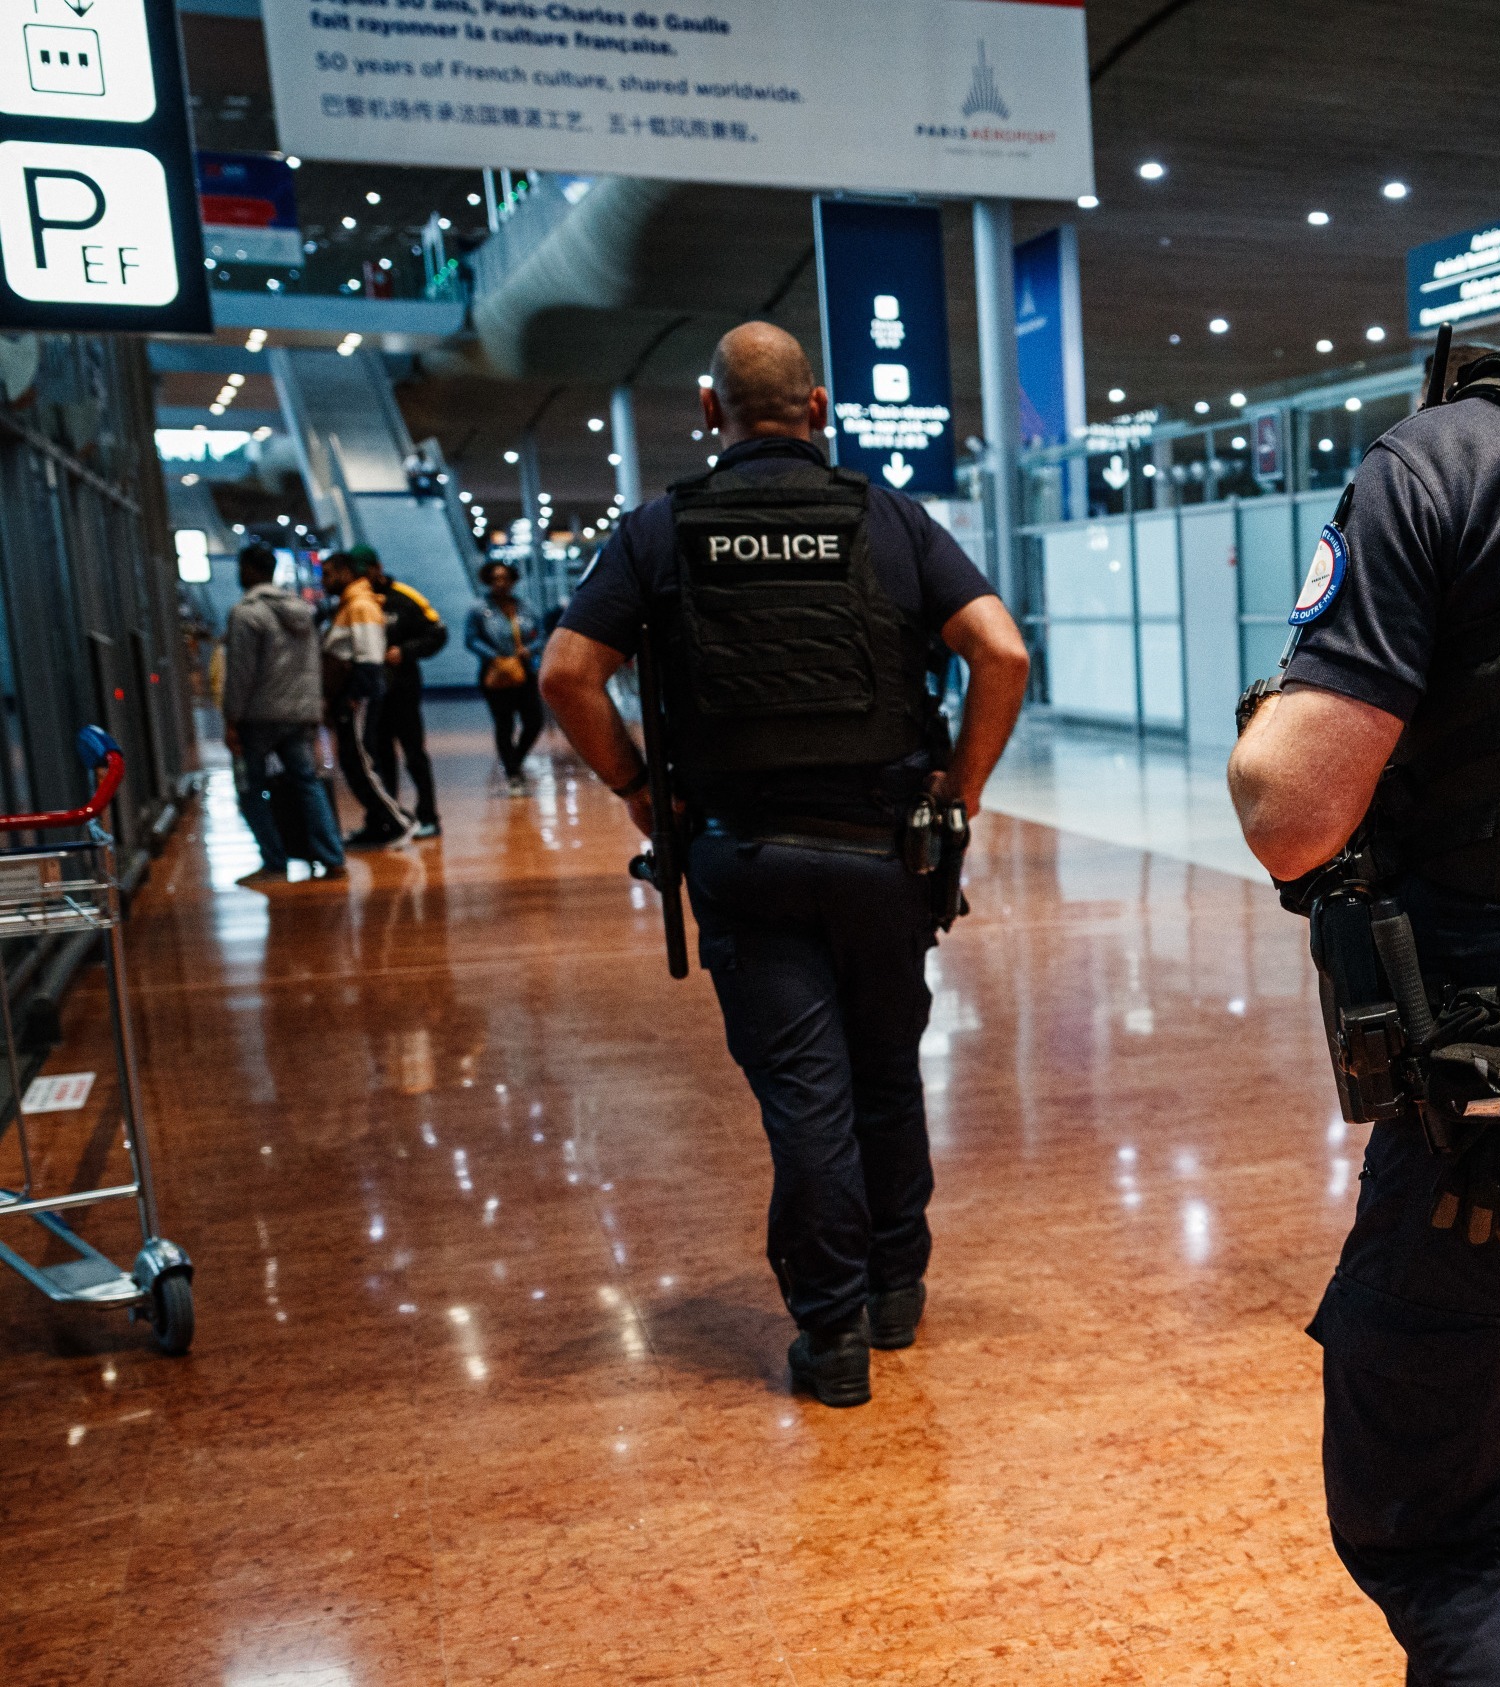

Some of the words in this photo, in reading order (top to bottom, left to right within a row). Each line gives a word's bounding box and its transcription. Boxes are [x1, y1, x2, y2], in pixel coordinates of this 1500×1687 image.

[310, 9, 351, 30] fait
[356, 17, 458, 38] rayonner
[464, 21, 487, 42] la
[491, 26, 569, 48] culture
[573, 30, 678, 56] française.
[482, 0, 627, 27] Paris-Charles
[631, 12, 660, 30] de
[664, 13, 731, 36] Gaulle
[315, 51, 348, 73] 50
[353, 58, 415, 77] years
[420, 59, 445, 79] of
[451, 60, 527, 84] French
[531, 69, 614, 93] culture,
[618, 75, 689, 97] shared
[694, 79, 804, 104] worldwide.
[23, 167, 107, 269] P
[81, 245, 140, 285] EF
[709, 534, 840, 561] POLICE
[1300, 584, 1336, 619] OUTRE-MER
